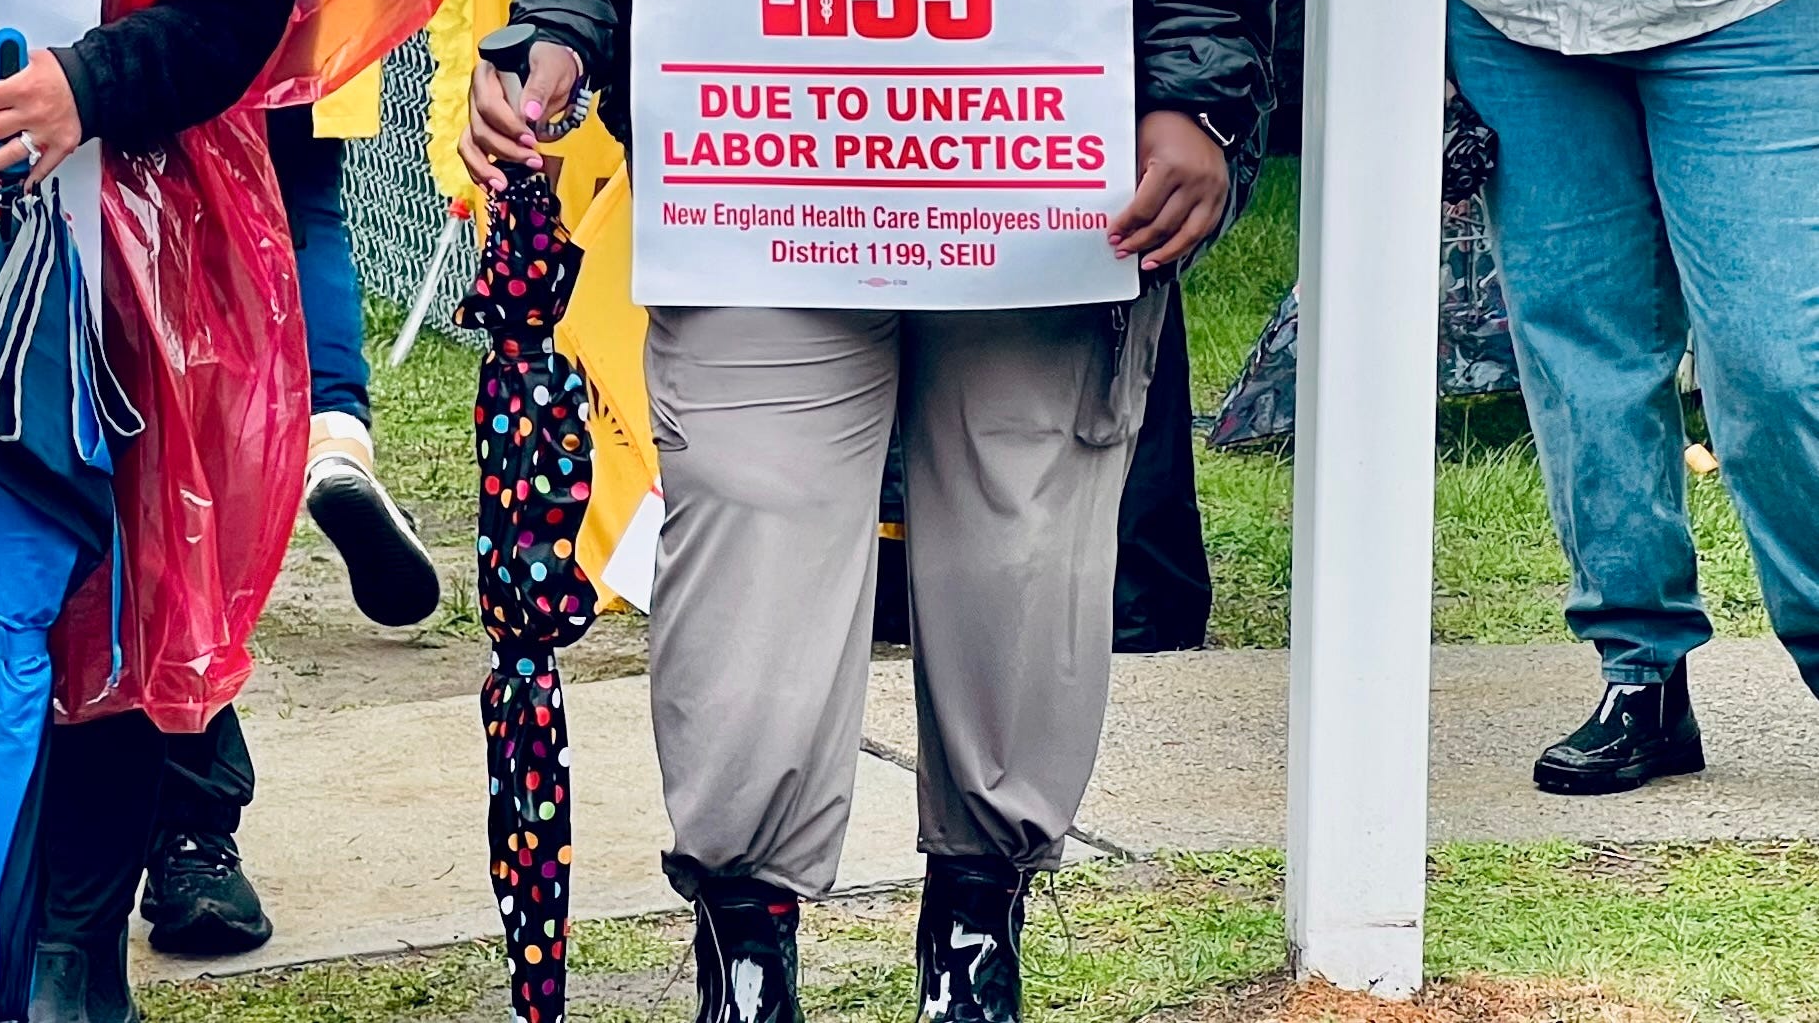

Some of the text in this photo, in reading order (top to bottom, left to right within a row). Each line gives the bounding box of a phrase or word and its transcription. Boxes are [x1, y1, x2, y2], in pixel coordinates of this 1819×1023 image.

[701, 85, 1066, 123] DUE TO UNFAIR
[664, 132, 1107, 172] LABOR PRACTICES
[663, 203, 1109, 235] New England Health Care Employees Union
[771, 240, 997, 270] District 1199, SEIU
